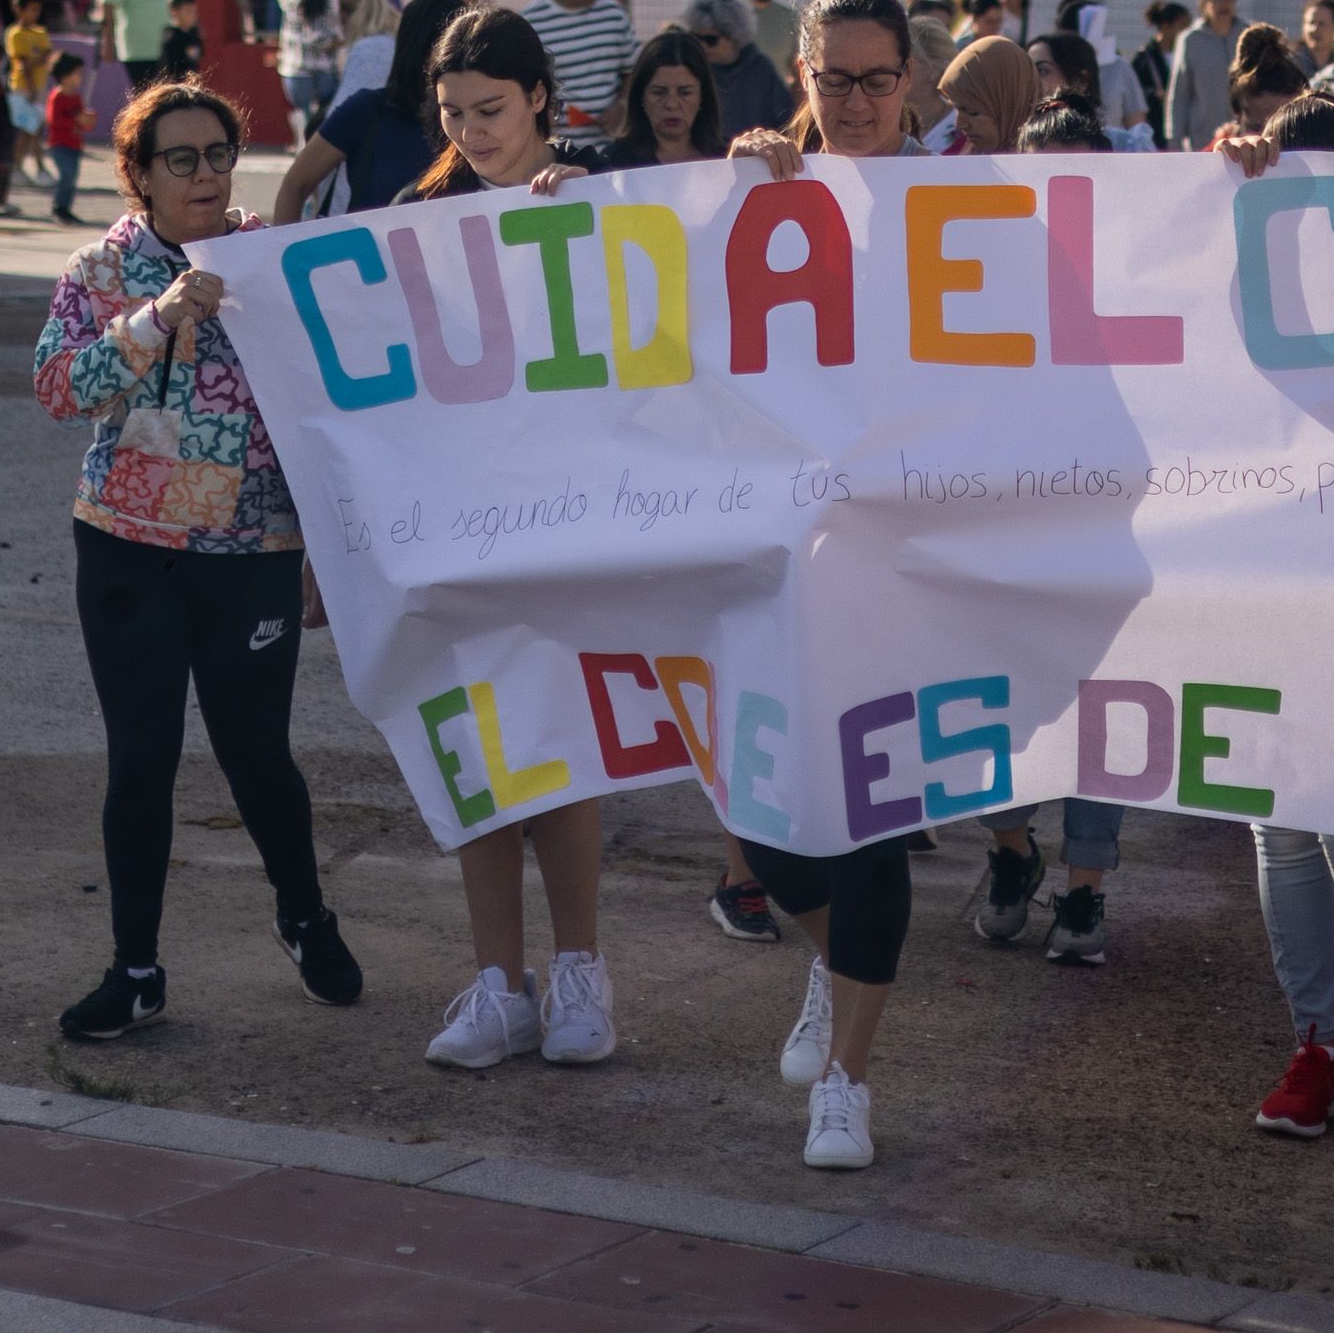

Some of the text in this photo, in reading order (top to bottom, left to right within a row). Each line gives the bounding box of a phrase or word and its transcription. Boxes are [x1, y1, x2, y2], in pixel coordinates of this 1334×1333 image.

[280, 178, 856, 412] CUIDA
[904, 174, 1185, 368] EL
[390, 500, 425, 544] el
[451, 476, 587, 559] segundo
[613, 468, 699, 531] hogar
[718, 466, 754, 513] de
[790, 459, 852, 507] tus
[256, 618, 285, 637] NIKE
[418, 680, 571, 830] EL
[838, 675, 1014, 843] ES
[1076, 678, 1282, 818] DE
